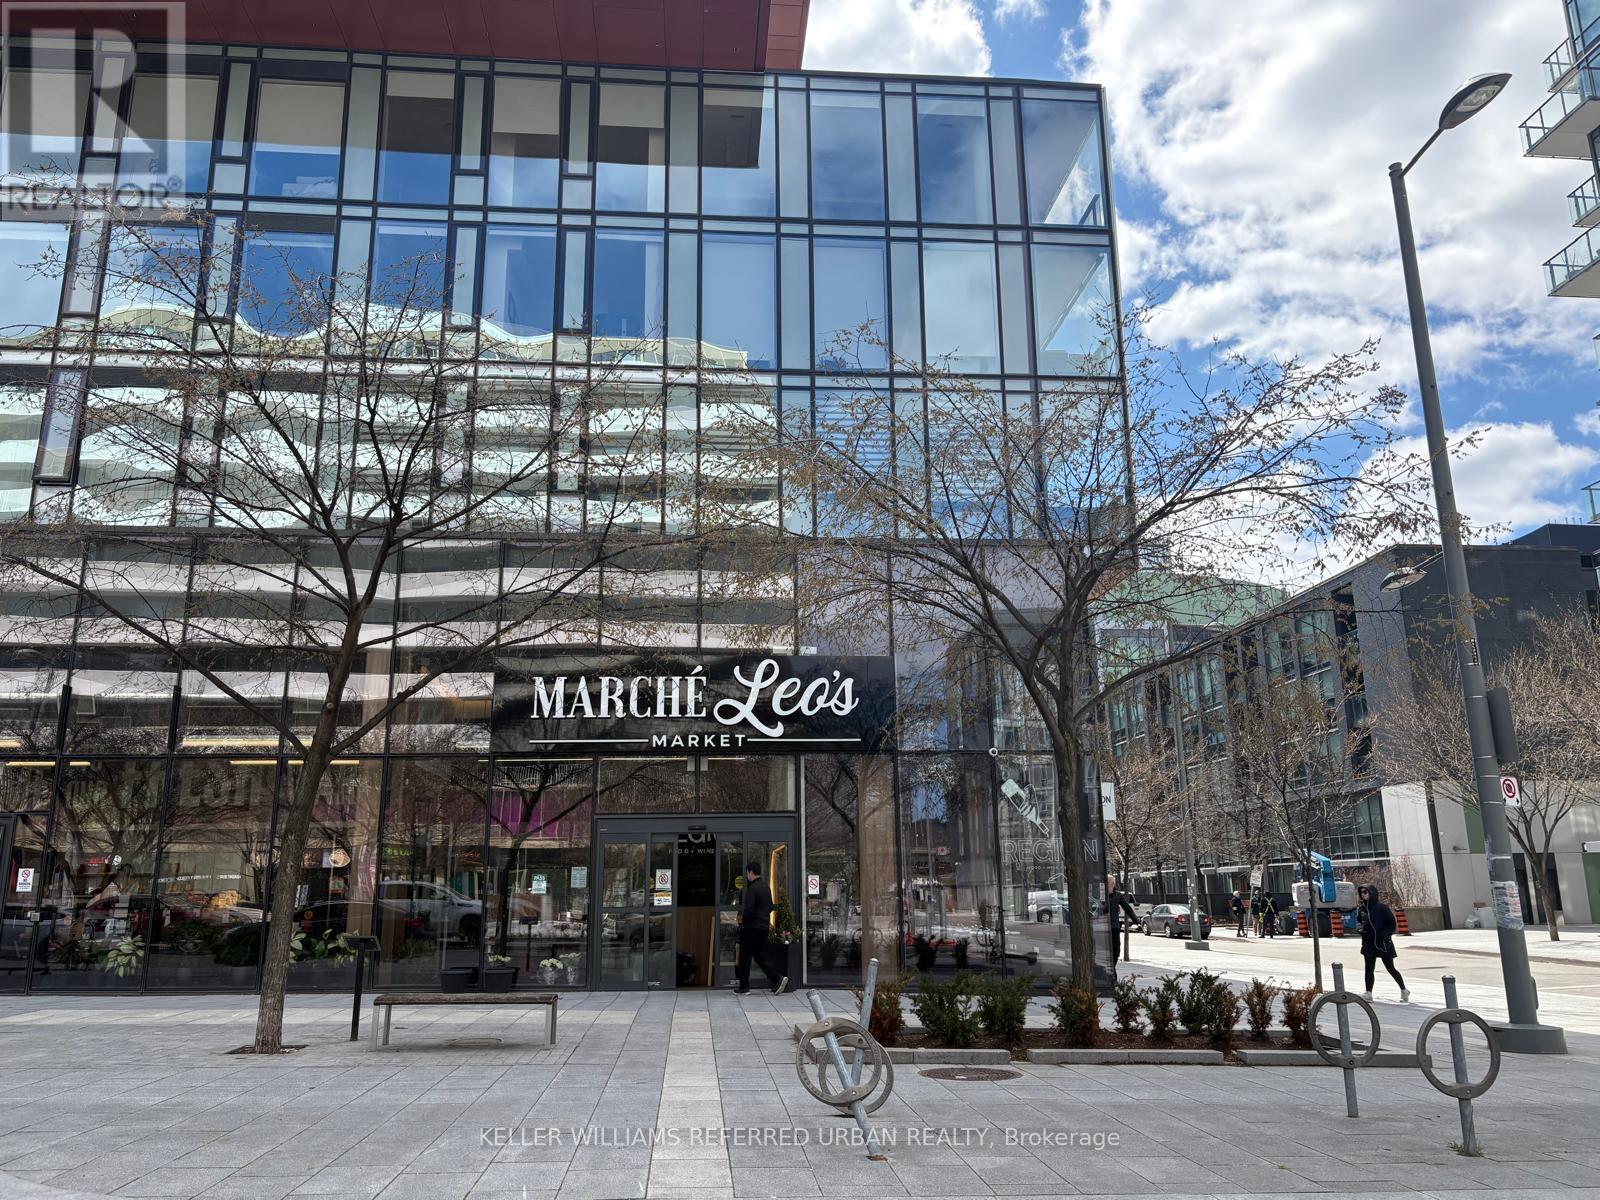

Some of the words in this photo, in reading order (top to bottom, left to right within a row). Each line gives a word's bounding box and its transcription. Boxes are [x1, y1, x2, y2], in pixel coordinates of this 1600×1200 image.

[530, 665, 707, 719] MARCHÉ
[713, 658, 860, 738] Leo's
[652, 734, 747, 748] MARKET
[1003, 840, 1098, 863] REGIN
